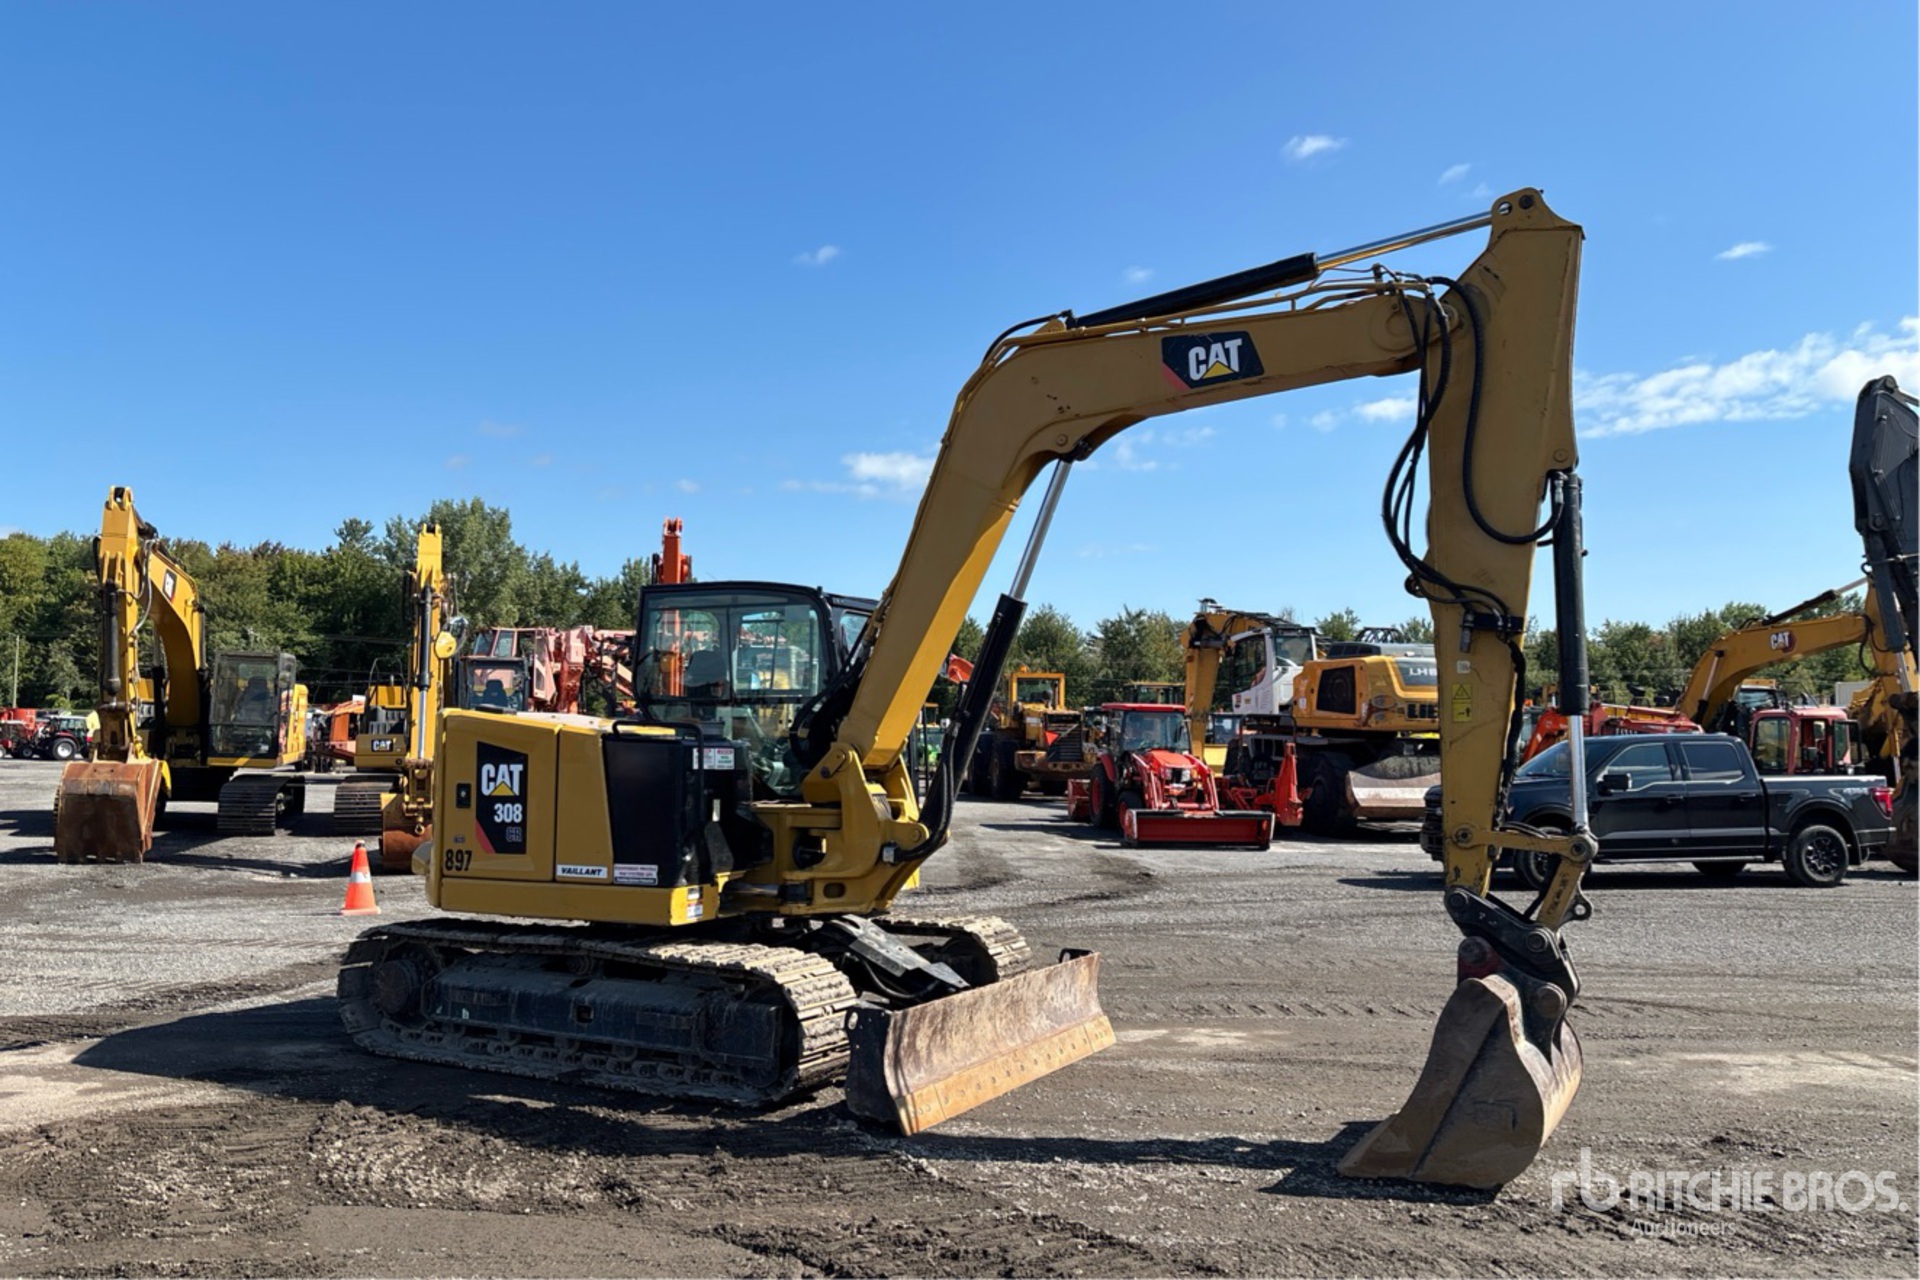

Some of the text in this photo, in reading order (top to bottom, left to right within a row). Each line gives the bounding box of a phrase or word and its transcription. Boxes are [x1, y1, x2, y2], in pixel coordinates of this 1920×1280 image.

[1188, 338, 1242, 380] CAT
[1770, 631, 1789, 649] CAT
[372, 740, 392, 751] CAT
[481, 763, 523, 796] CAT
[493, 803, 523, 823] 308
[506, 826, 523, 842] CR
[445, 848, 472, 872] 897
[561, 866, 603, 877] VAILLANT
